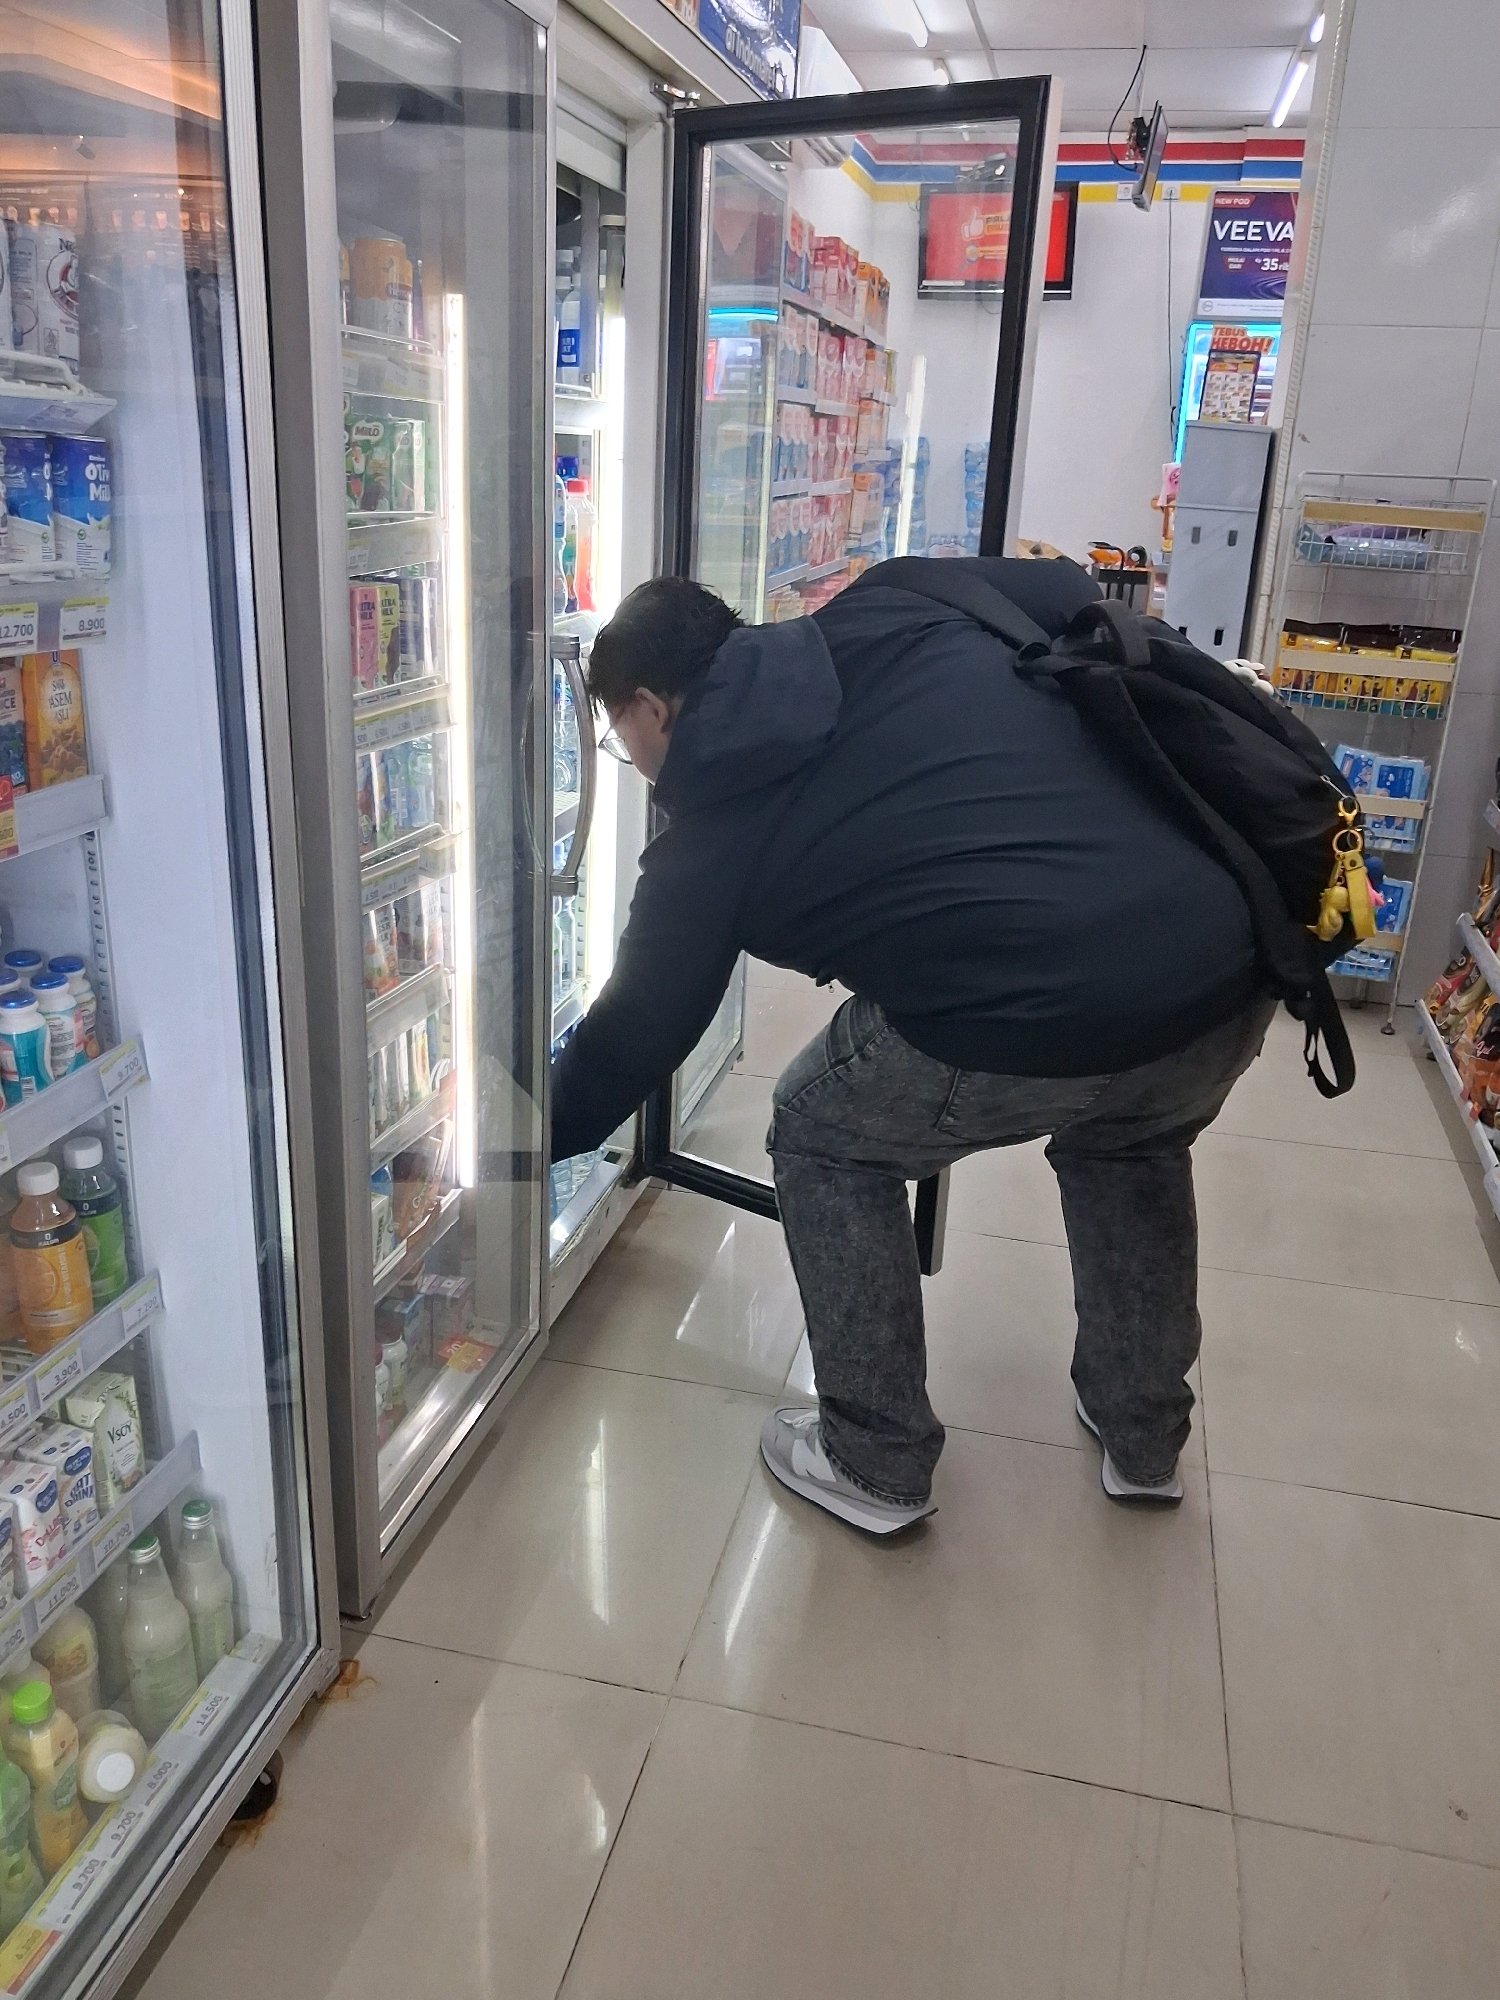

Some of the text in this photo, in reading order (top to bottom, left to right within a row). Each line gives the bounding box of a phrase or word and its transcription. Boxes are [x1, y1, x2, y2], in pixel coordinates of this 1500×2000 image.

[1211, 337, 1274, 352] HEBOH!
[1213, 327, 1247, 337] TEBUS
[78, 617, 105, 632] 8.900
[117, 1056, 140, 1082] 9.700
[54, 1360, 79, 1386] 3.900
[196, 1695, 223, 1727] 14.500
[146, 1761, 173, 1791] 8.000
[110, 1810, 137, 1842] 9.700
[72, 1858, 101, 1892] 9.700
